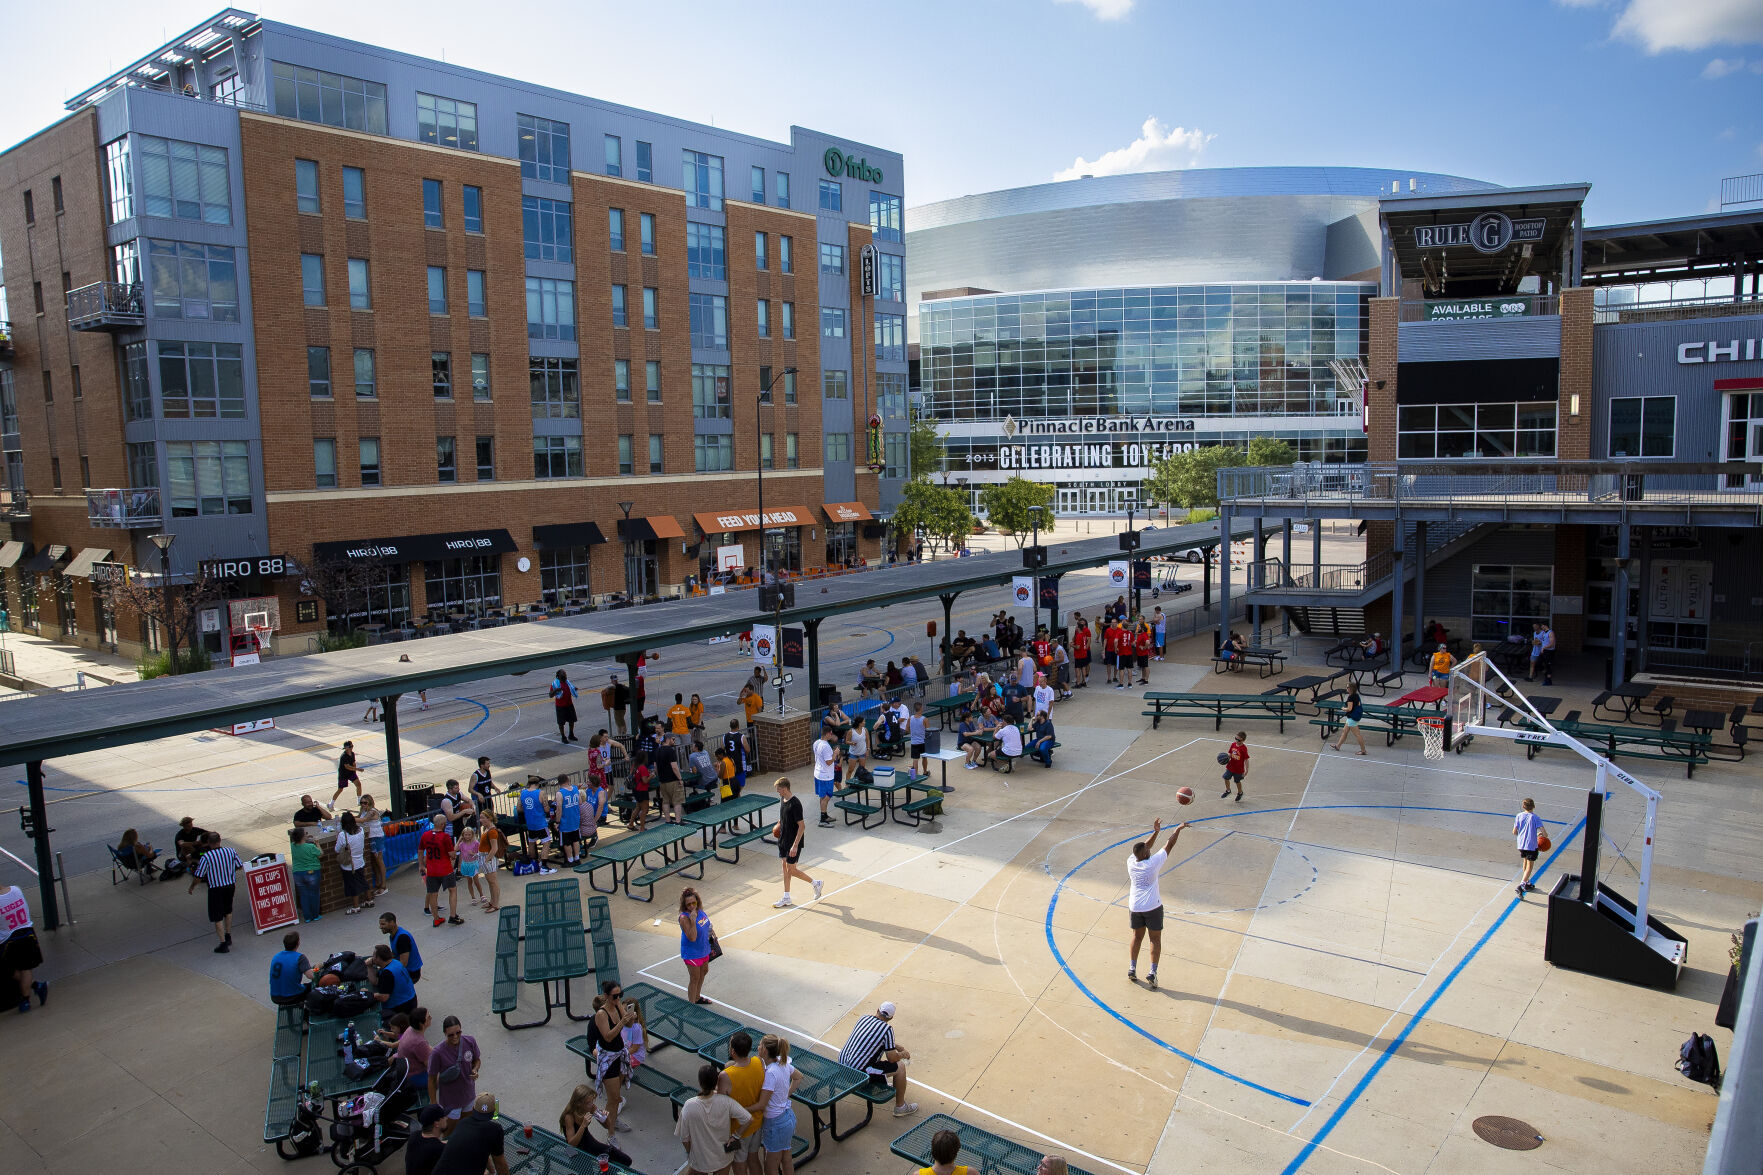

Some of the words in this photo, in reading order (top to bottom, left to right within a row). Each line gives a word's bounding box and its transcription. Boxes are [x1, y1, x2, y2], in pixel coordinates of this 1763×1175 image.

[846, 155, 884, 184] fnbo
[1420, 225, 1469, 246] RULE
[1483, 222, 1500, 246] G
[1514, 222, 1543, 231] ROOFTOP
[1519, 230, 1538, 238] PATIO
[864, 258, 873, 293] LOFTS
[1431, 303, 1493, 315] AVAILABLE
[1677, 338, 1763, 364] CHI
[1019, 417, 1094, 434] Pinnacle
[1096, 416, 1139, 433] Bank
[1143, 416, 1195, 432] Arena
[965, 453, 995, 463] 2013
[1000, 444, 1112, 468] CELEBRATING
[716, 516, 745, 528] FEED
[741, 513, 772, 526] YOUR
[768, 511, 798, 524] HEAD
[204, 562, 251, 579] HIRO
[258, 559, 284, 574] 88
[891, 715, 899, 724] 4
[728, 740, 736, 752] 3
[602, 750, 608, 759] 0
[1616, 772, 1635, 786] CLUB
[524, 797, 534, 810] 9
[564, 794, 580, 809] 10
[254, 874, 264, 885] NO
[264, 870, 281, 882] CUPS
[258, 882, 282, 897] BEYOND
[256, 898, 271, 910] THIS
[271, 893, 289, 906] POINT
[5, 908, 28, 930] 30
[271, 962, 283, 979] 9
